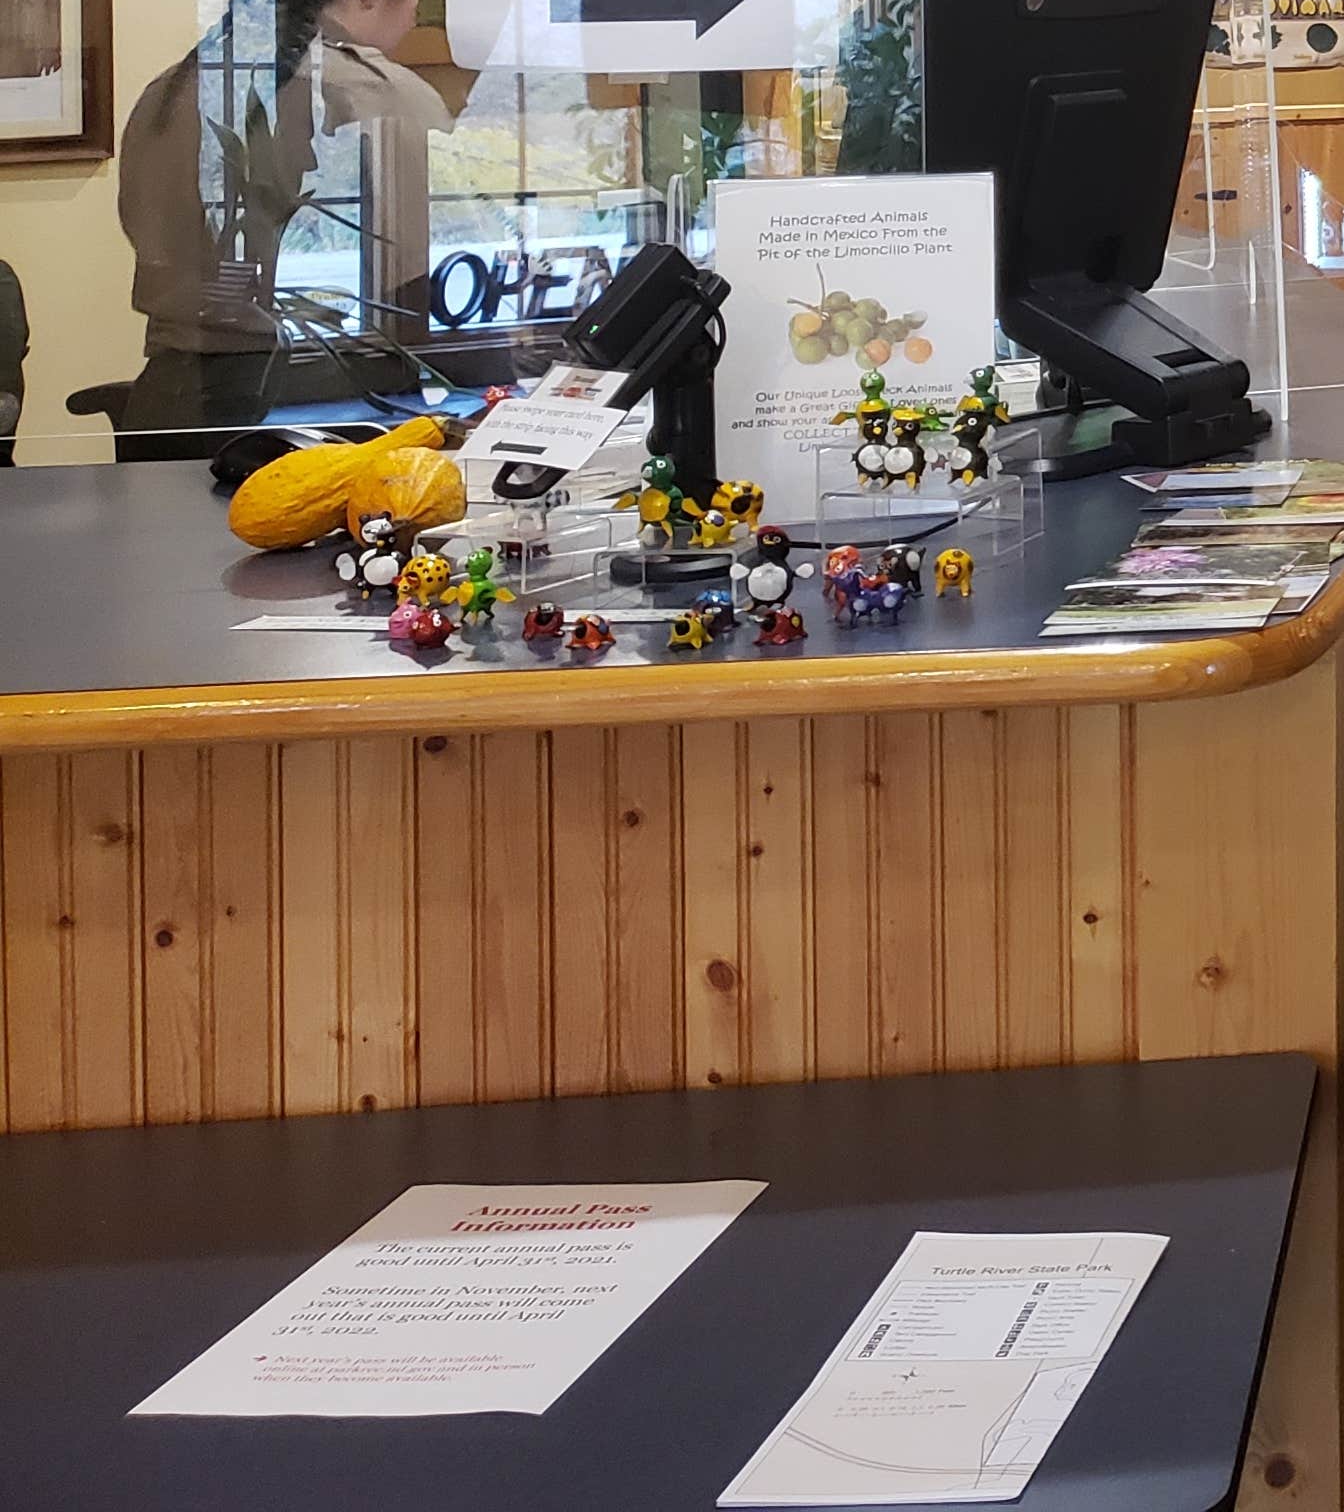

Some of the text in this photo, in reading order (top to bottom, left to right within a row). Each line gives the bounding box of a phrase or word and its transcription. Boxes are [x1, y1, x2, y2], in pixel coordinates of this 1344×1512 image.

[770, 211, 928, 228] Handcrafted Animals
[759, 226, 947, 244] Made in Mexico From the
[757, 243, 953, 261] Pit of the Limoncillo Plant
[755, 383, 953, 403] Our Unique Loos Animals
[755, 405, 785, 415] make
[790, 405, 796, 413] a
[799, 402, 835, 414] Great
[731, 416, 818, 429] and show your
[468, 1204, 653, 1216] Annual Pass
[450, 1219, 636, 1232] Information
[375, 1241, 633, 1254] The current annual pass is
[355, 1256, 412, 1268] good
[411, 1256, 463, 1266] until
[463, 1256, 518, 1267] April
[563, 1256, 617, 1265] 2021.
[931, 1263, 1113, 1276] Turtle River State Park
[322, 1284, 619, 1296] Sometime in November, next
[302, 1297, 595, 1310] year's annual pass will come
[291, 1309, 565, 1323] out that is good until April
[320, 1326, 379, 1335] 2022.
